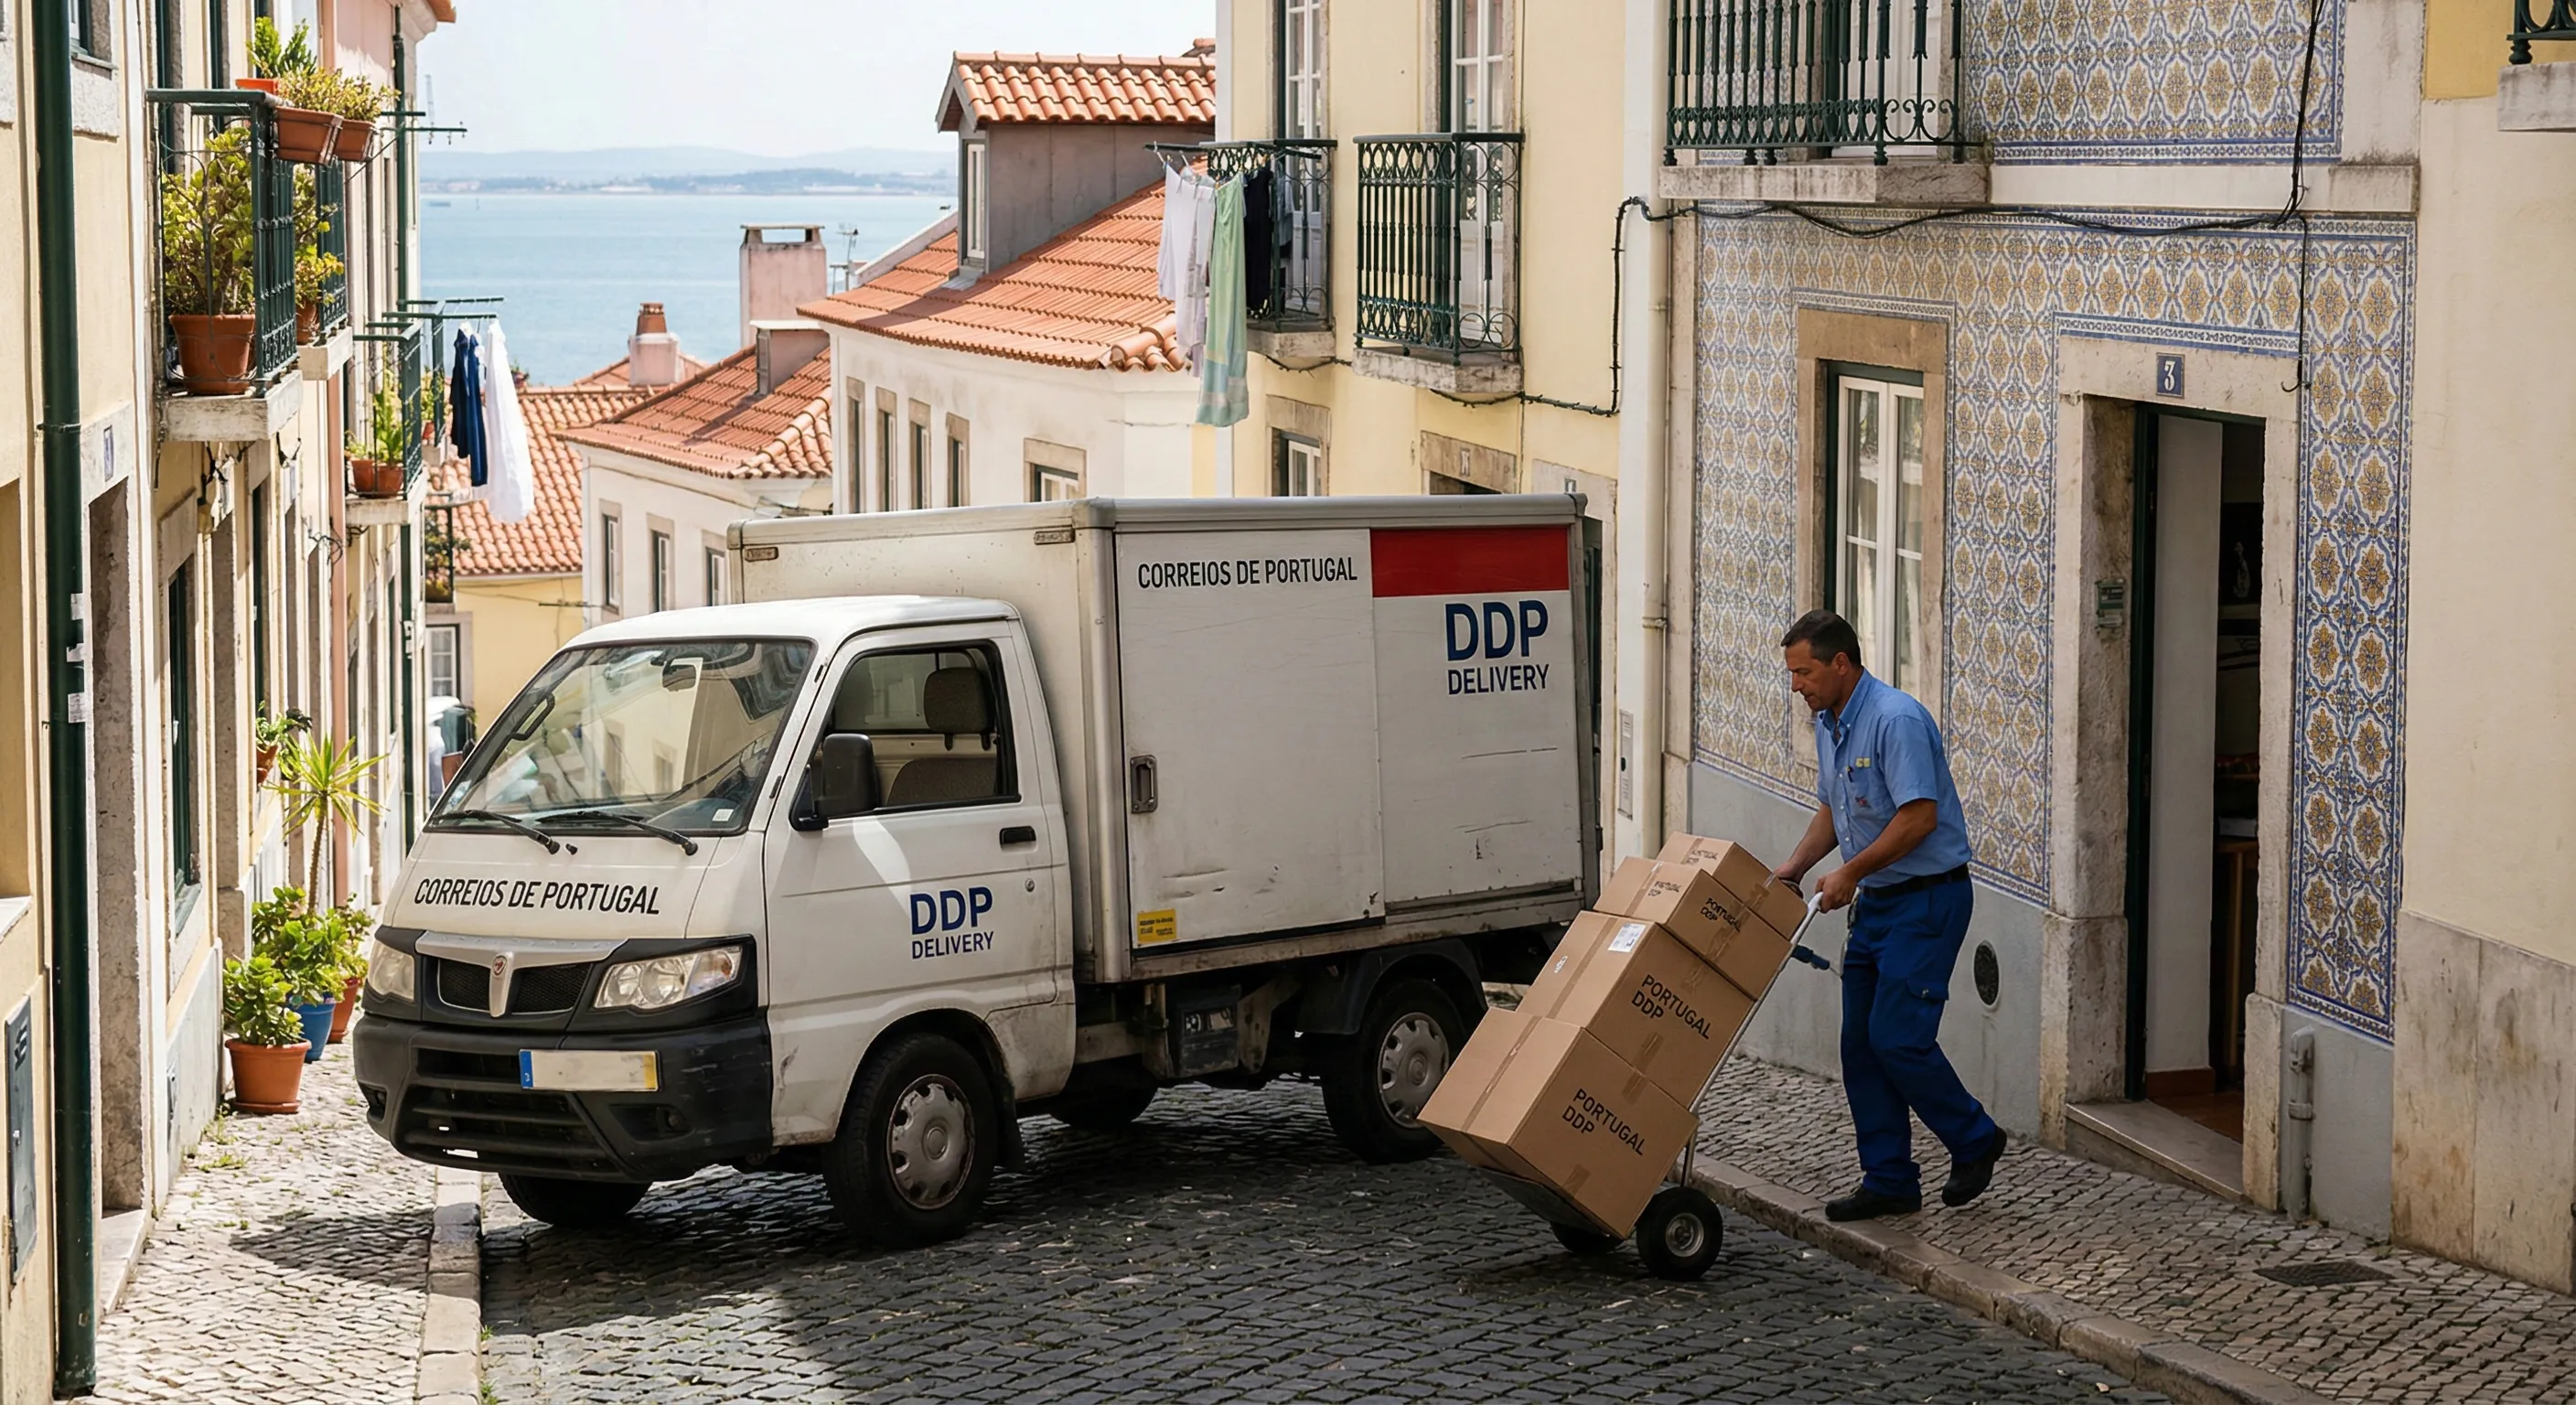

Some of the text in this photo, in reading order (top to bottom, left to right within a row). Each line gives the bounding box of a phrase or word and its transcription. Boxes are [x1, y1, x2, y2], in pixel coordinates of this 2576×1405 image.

[2164, 360, 2175, 391] 3
[1138, 557, 1358, 588] CORREIOS DE PORTUGAL
[1445, 600, 1549, 661] DDP
[1448, 664, 1549, 694] DELIVERY
[414, 878, 660, 915] CORREIOS DE PORTUGAL
[910, 886, 993, 935] DDP
[912, 931, 993, 960] DELIVERY
[1632, 990, 1664, 1019] DDP
[1642, 974, 1711, 1040] PORTUGAL
[1562, 1105, 1594, 1133] DDP
[1573, 1089, 1645, 1156] PORTUGAL
